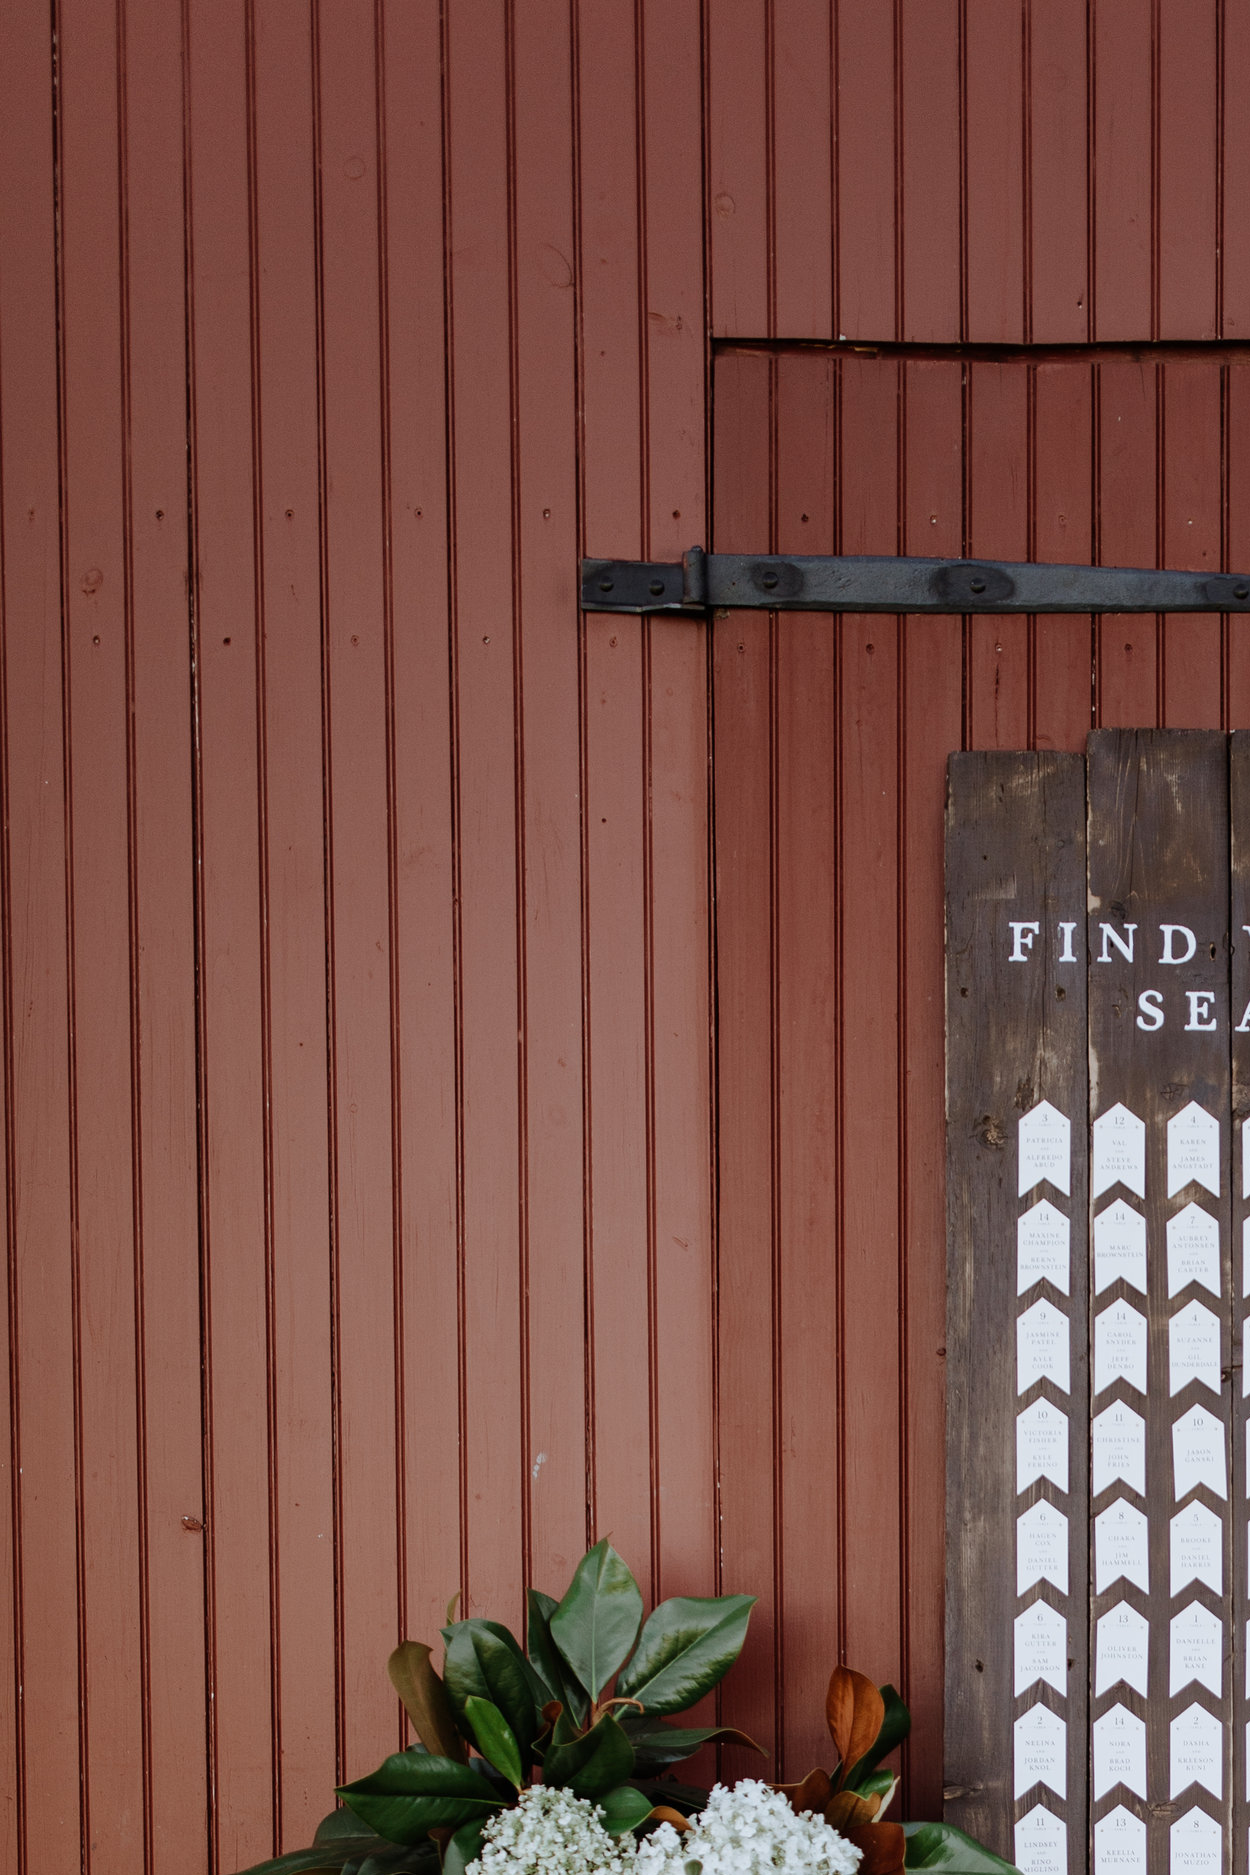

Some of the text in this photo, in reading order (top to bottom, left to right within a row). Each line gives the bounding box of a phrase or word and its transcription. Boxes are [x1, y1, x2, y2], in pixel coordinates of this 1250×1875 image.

[1009, 922, 1196, 964] FIND
[1115, 1116, 1125, 1125] 12
[1040, 1213, 1049, 1221] 14
[1116, 1212, 1125, 1221] 14
[1117, 1312, 1126, 1320] 14
[1038, 1410, 1048, 1419] 10
[1115, 1413, 1123, 1422] 11
[1193, 1418, 1204, 1427] 10
[1119, 1614, 1129, 1623] 13
[1101, 1652, 1143, 1660] JOHNSTON
[1115, 1717, 1124, 1726] 14
[1109, 1740, 1131, 1748] NORA
[1036, 1817, 1044, 1827] 11
[1116, 1818, 1127, 1827] 13
